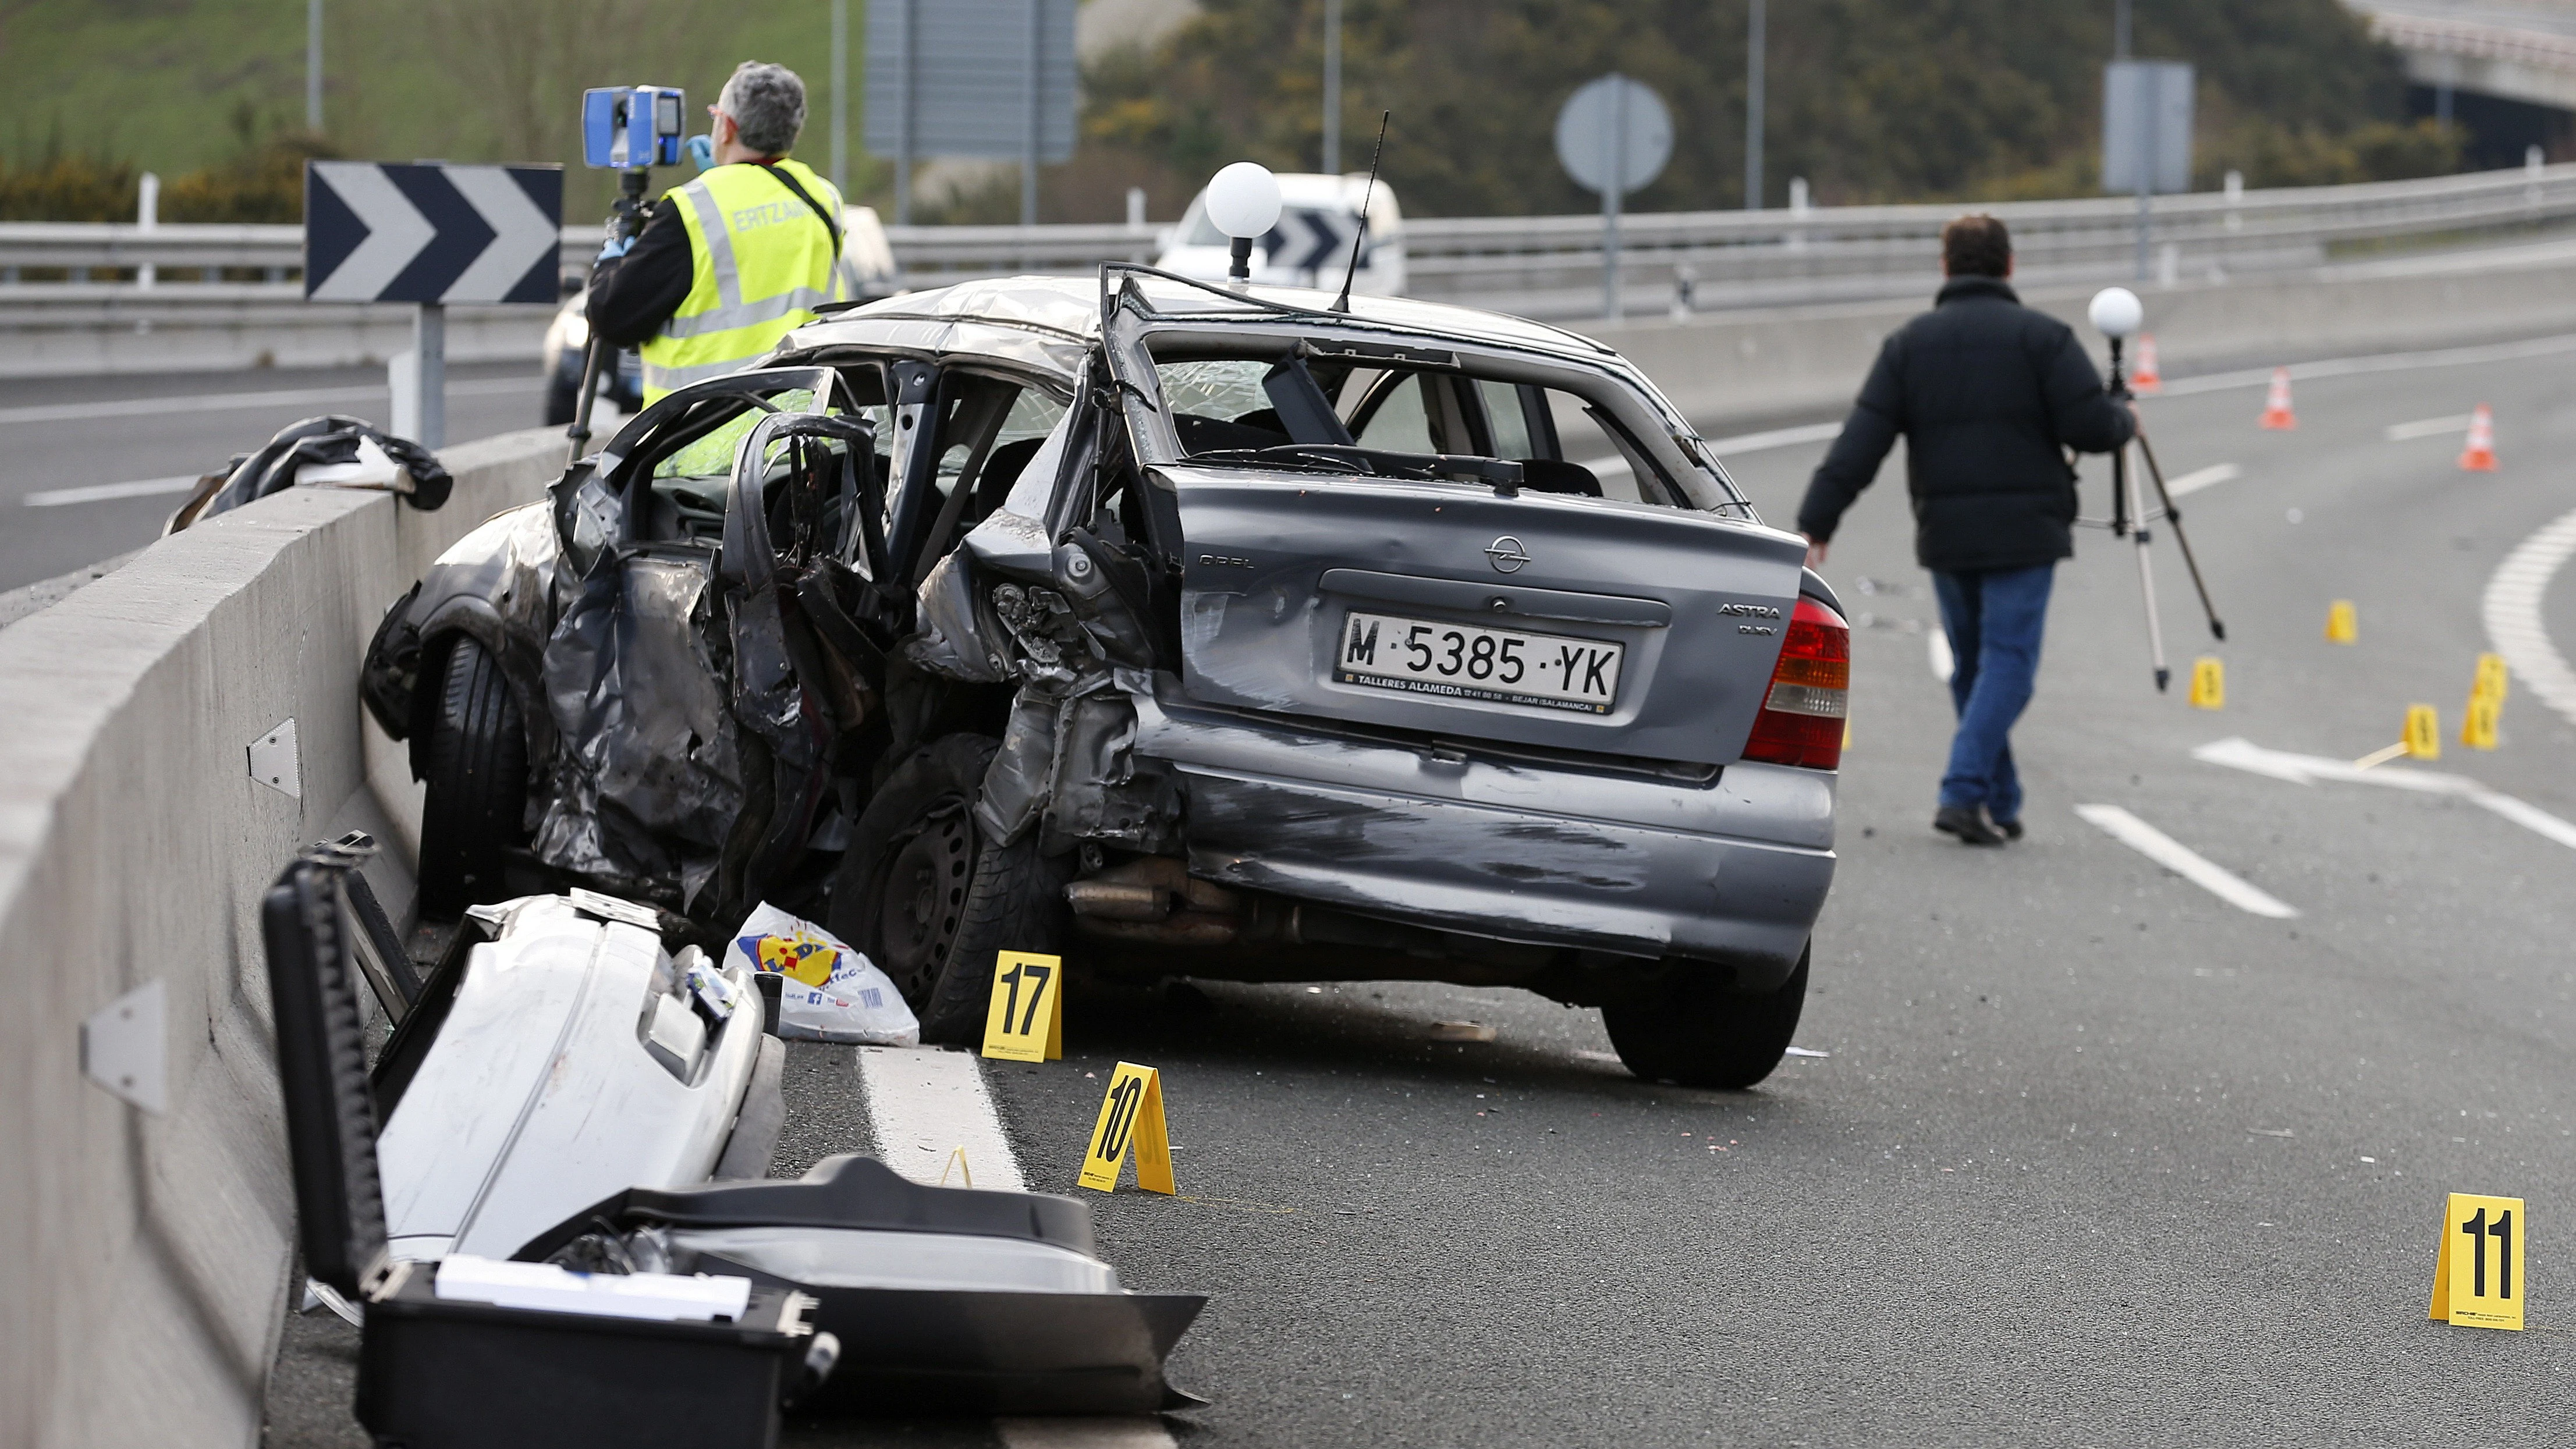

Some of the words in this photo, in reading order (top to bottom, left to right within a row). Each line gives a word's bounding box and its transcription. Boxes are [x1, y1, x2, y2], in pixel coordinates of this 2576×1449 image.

[1199, 553, 1255, 569] OPEL
[1717, 603, 1781, 620] ASTRA
[1347, 618, 1380, 665] M
[1406, 626, 1524, 684] 5385
[1561, 645, 1615, 695] YK
[1358, 675, 1406, 690] TALLERES
[1408, 682, 1462, 697] ALAMEDA
[1001, 963, 1051, 1035] 17
[1096, 1075, 1142, 1162] 10
[2462, 1208, 2511, 1299] 11
